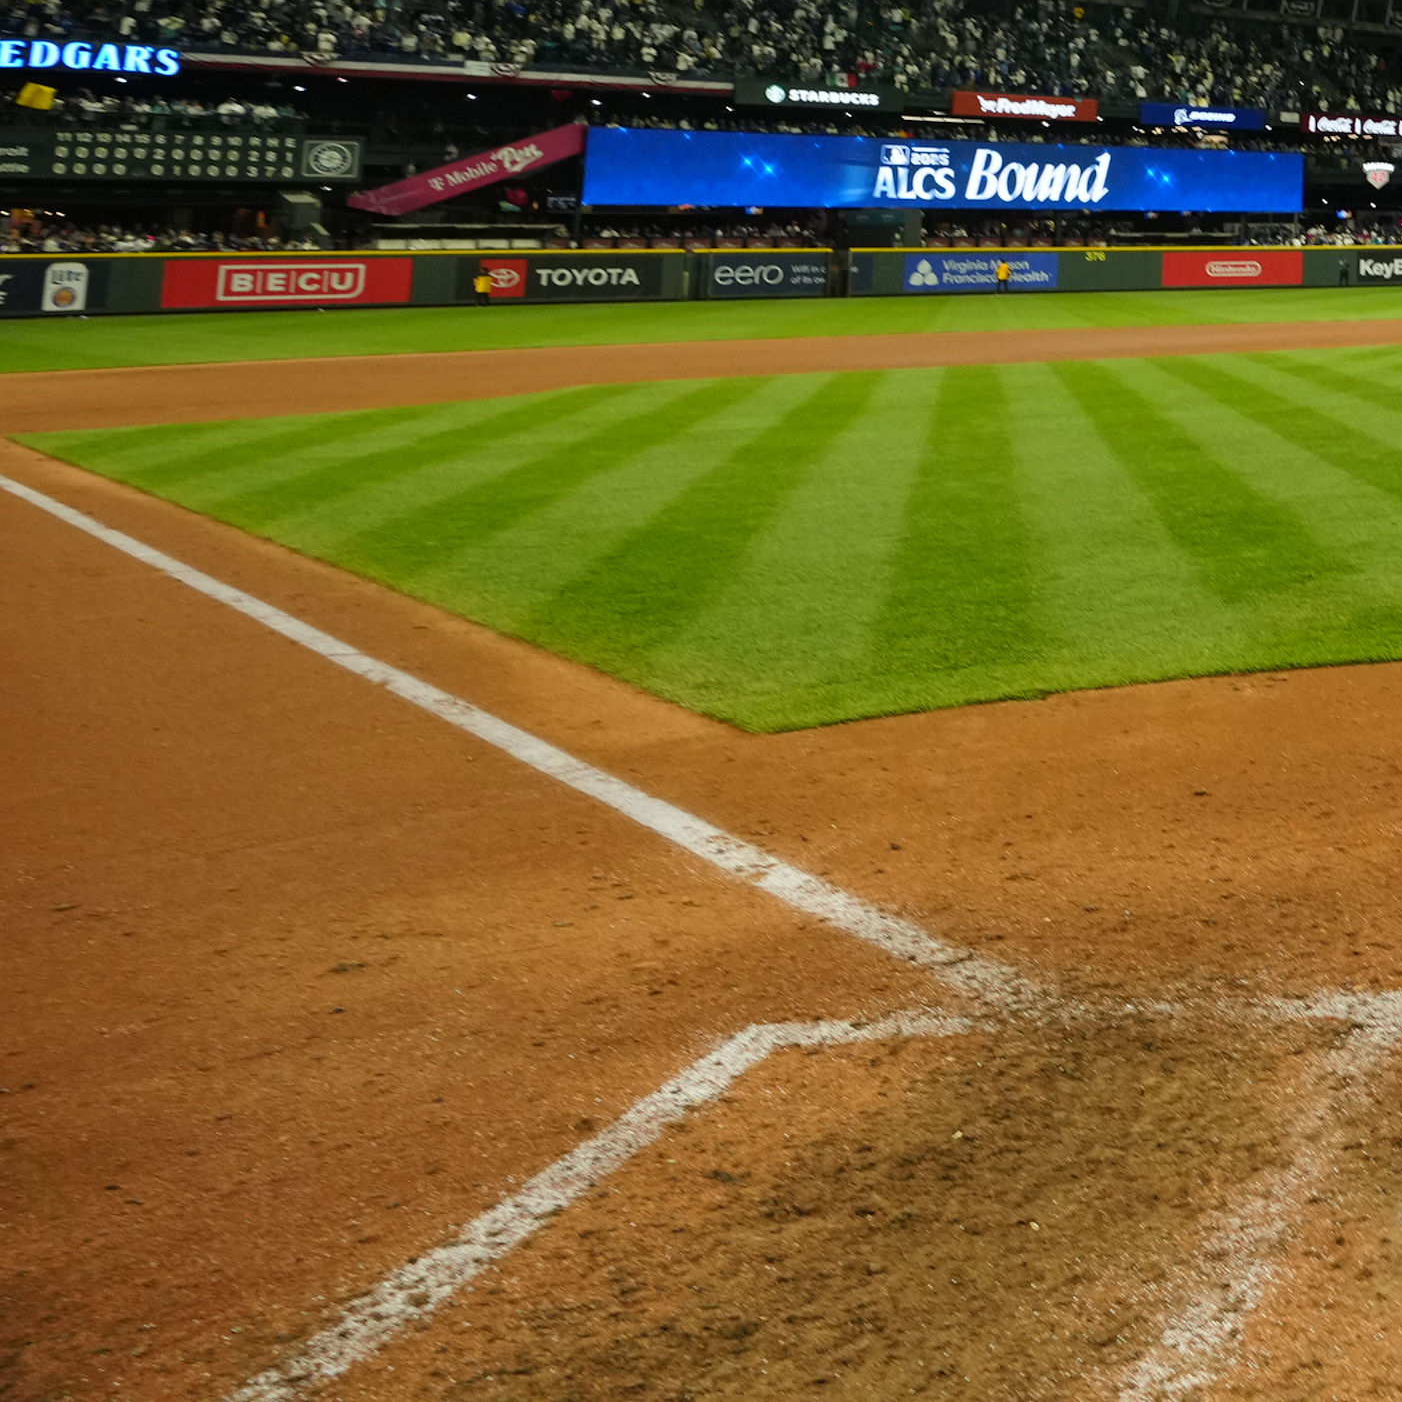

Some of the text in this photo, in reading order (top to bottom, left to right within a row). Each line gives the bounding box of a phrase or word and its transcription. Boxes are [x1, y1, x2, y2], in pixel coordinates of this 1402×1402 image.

[0, 39, 181, 76] EDGAR'S
[788, 88, 880, 106] STARBUCKS
[445, 161, 499, 187] Mobile
[873, 148, 1112, 203] ALCS Bound
[714, 265, 784, 286] eero
[942, 259, 1030, 274] Virginia Mson
[535, 268, 641, 287] TOYOTA
